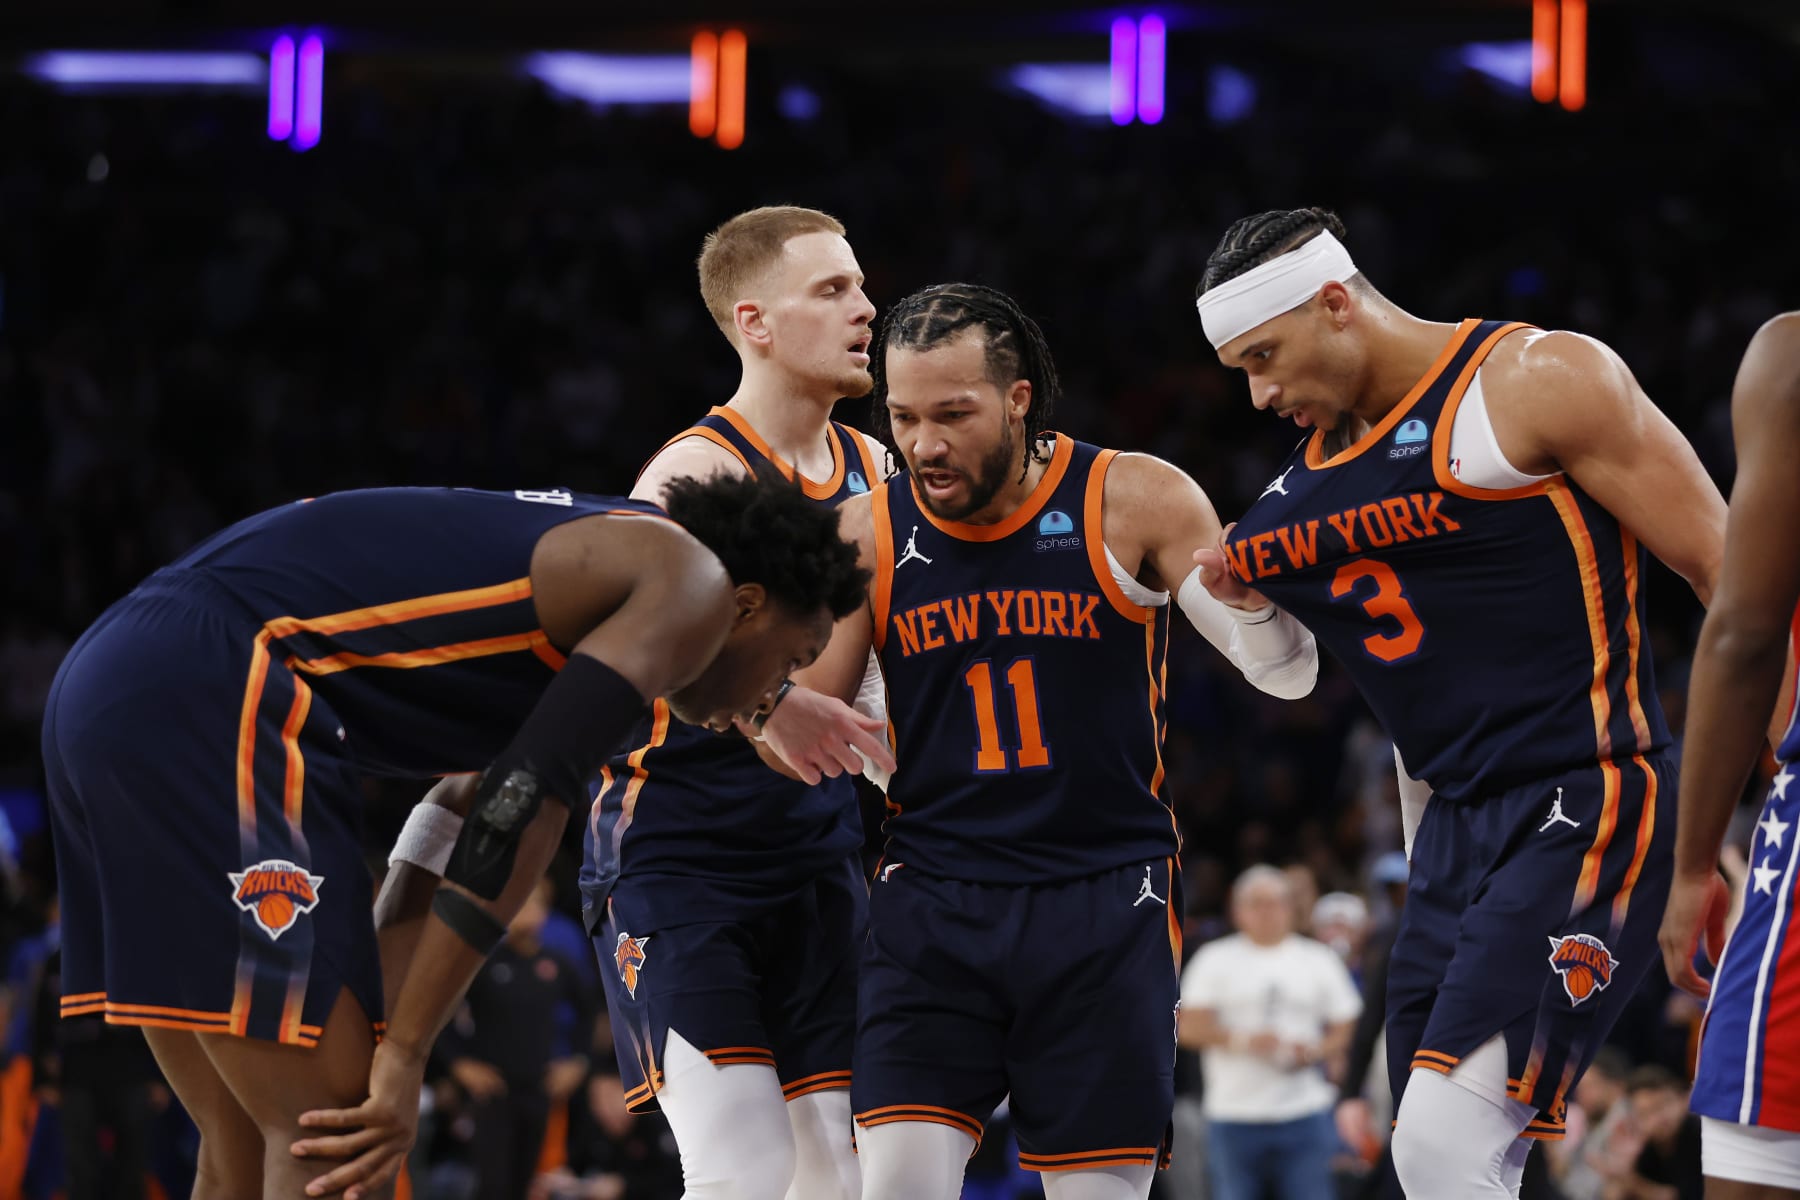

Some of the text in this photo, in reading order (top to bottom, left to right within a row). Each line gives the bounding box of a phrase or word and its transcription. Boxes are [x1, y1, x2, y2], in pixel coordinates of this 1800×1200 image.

[1390, 445, 1428, 459] spher
[1036, 537, 1080, 550] sphere
[1224, 492, 1461, 583] NEW YORK
[893, 590, 1101, 657] NEW YORK
[1329, 557, 1425, 663] 3
[964, 658, 1050, 772] 11
[236, 871, 316, 903] KNICKS
[1552, 939, 1610, 982] KNICKS
